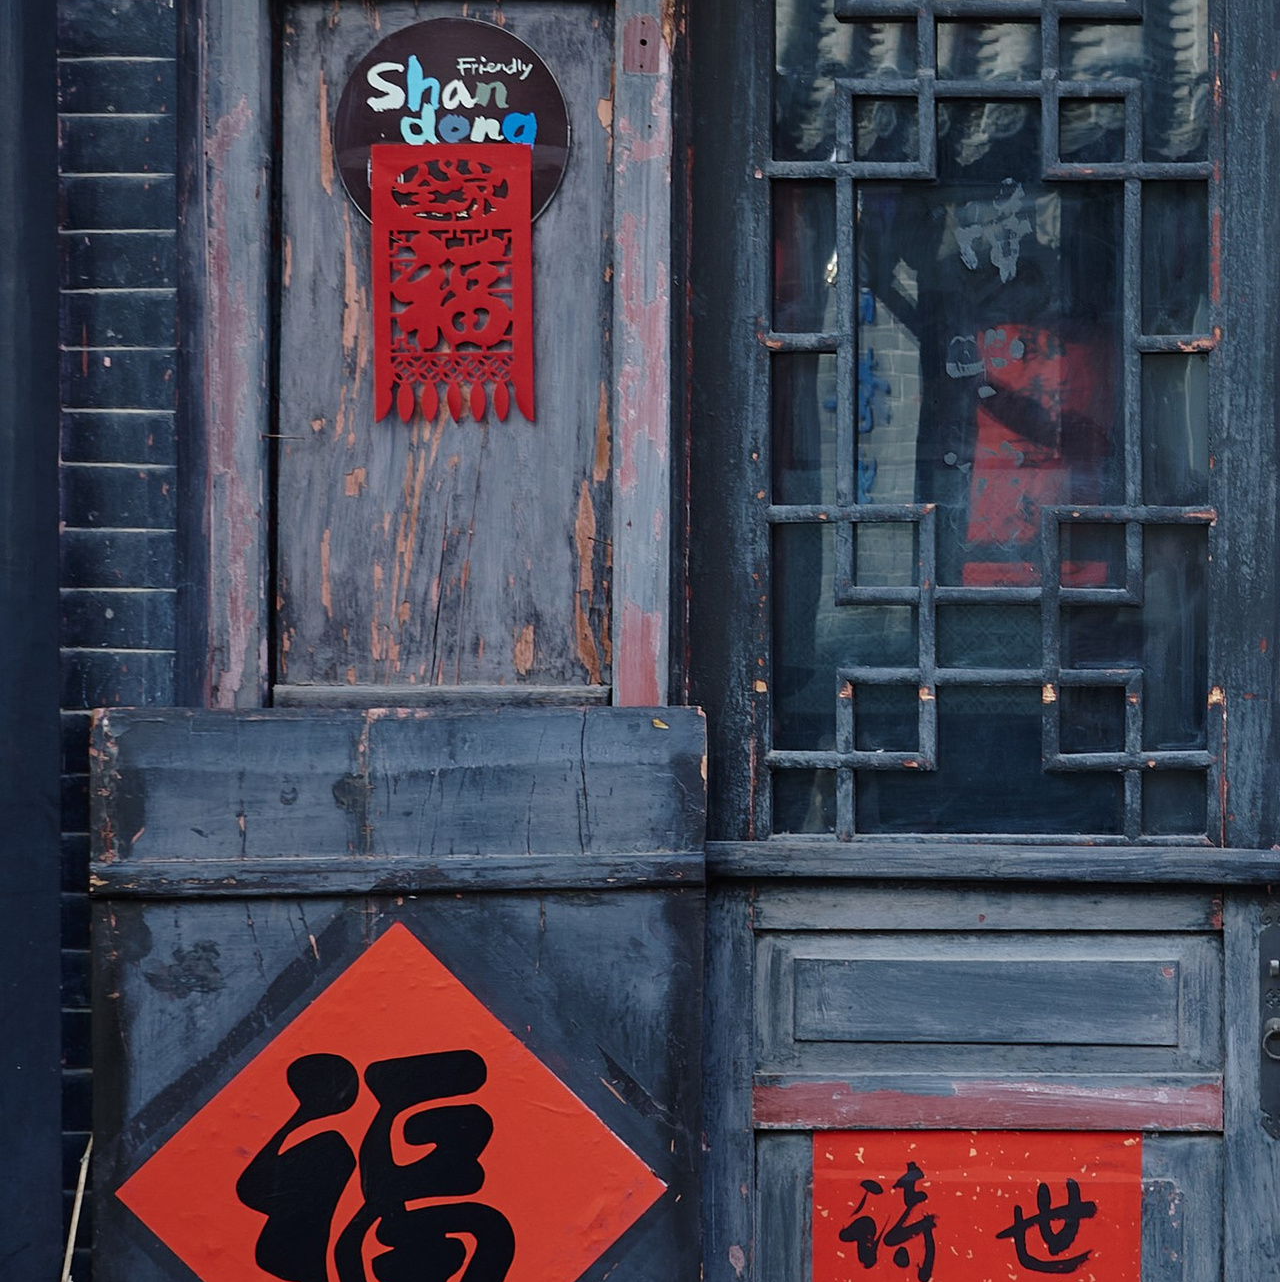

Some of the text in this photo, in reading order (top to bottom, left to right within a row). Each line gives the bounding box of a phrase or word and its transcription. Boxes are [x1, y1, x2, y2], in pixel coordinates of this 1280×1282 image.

[366, 54, 509, 112] Shan
[457, 56, 533, 80] Friendly
[391, 231, 513, 350] 福
